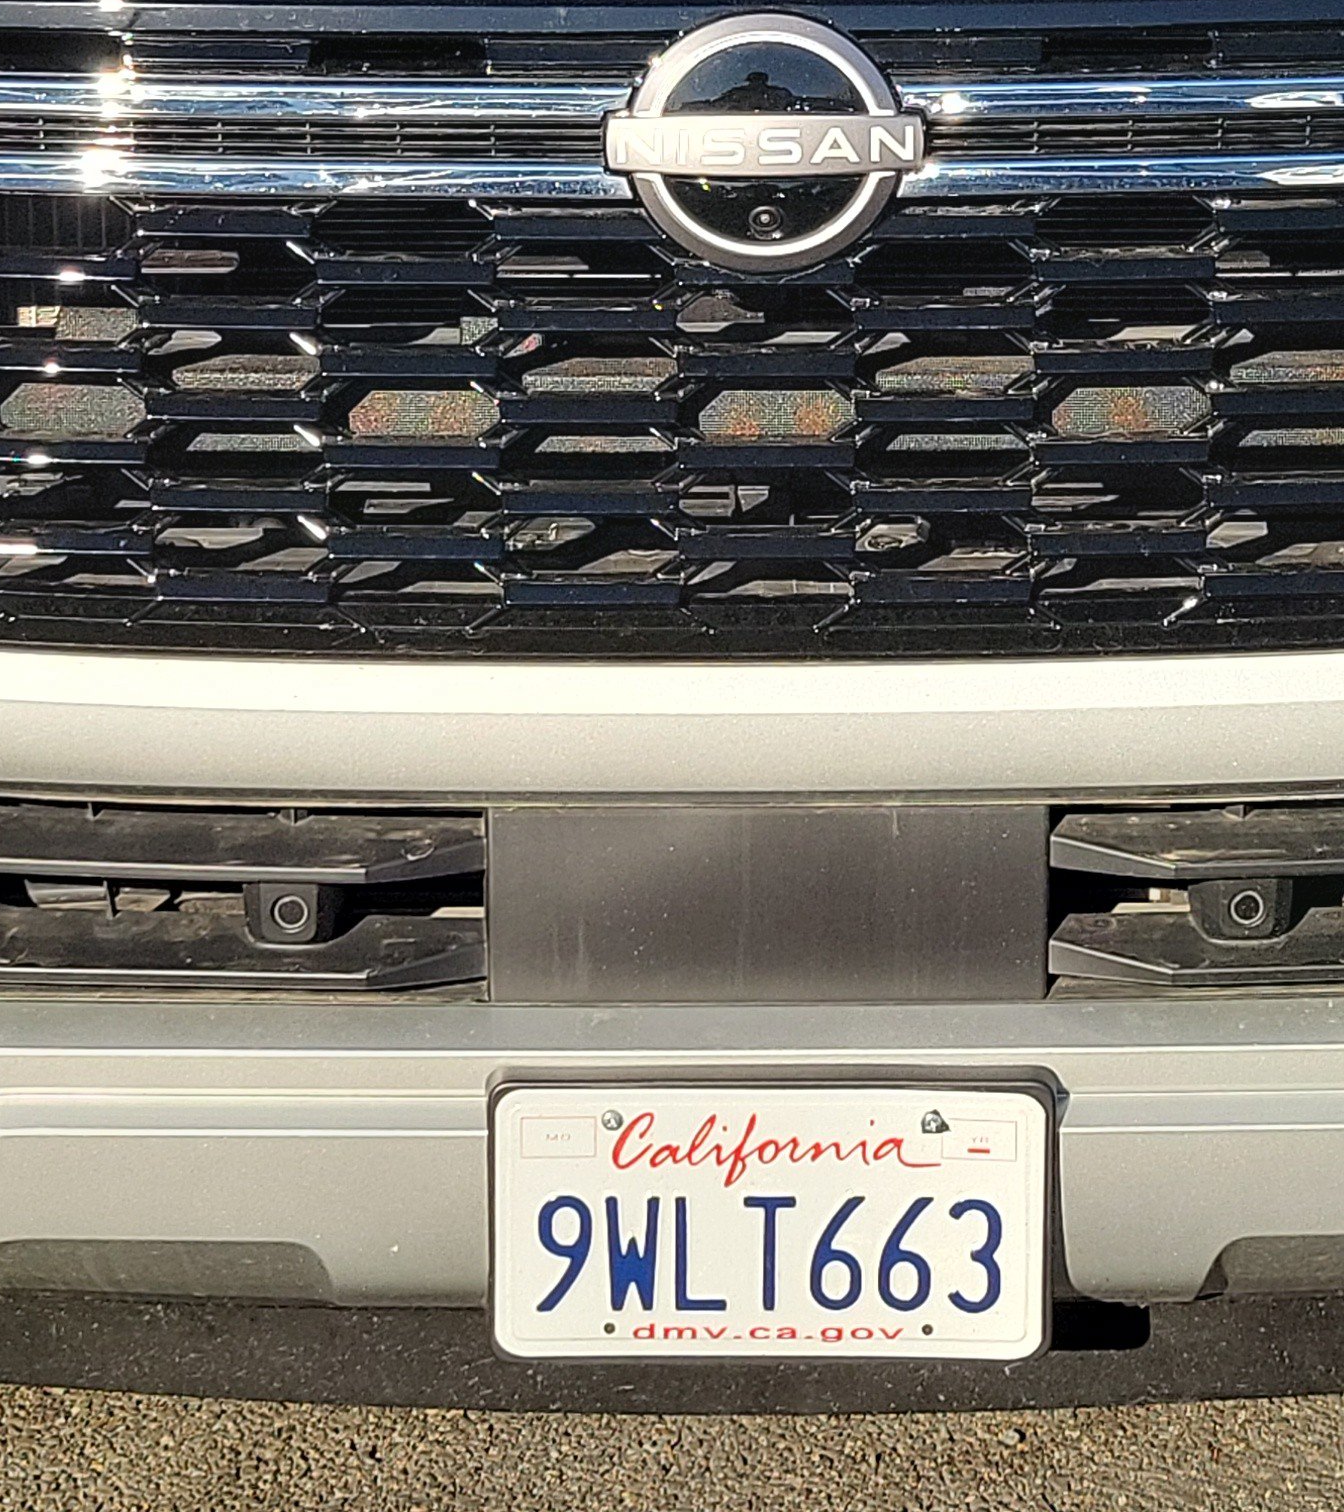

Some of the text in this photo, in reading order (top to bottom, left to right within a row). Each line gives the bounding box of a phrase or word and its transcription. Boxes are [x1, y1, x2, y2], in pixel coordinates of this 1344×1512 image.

[615, 124, 916, 167] NISSAN
[610, 1111, 942, 1187] California
[536, 1194, 1003, 1314] 9WLT663
[632, 1322, 905, 1343] dmv.ca.gov
